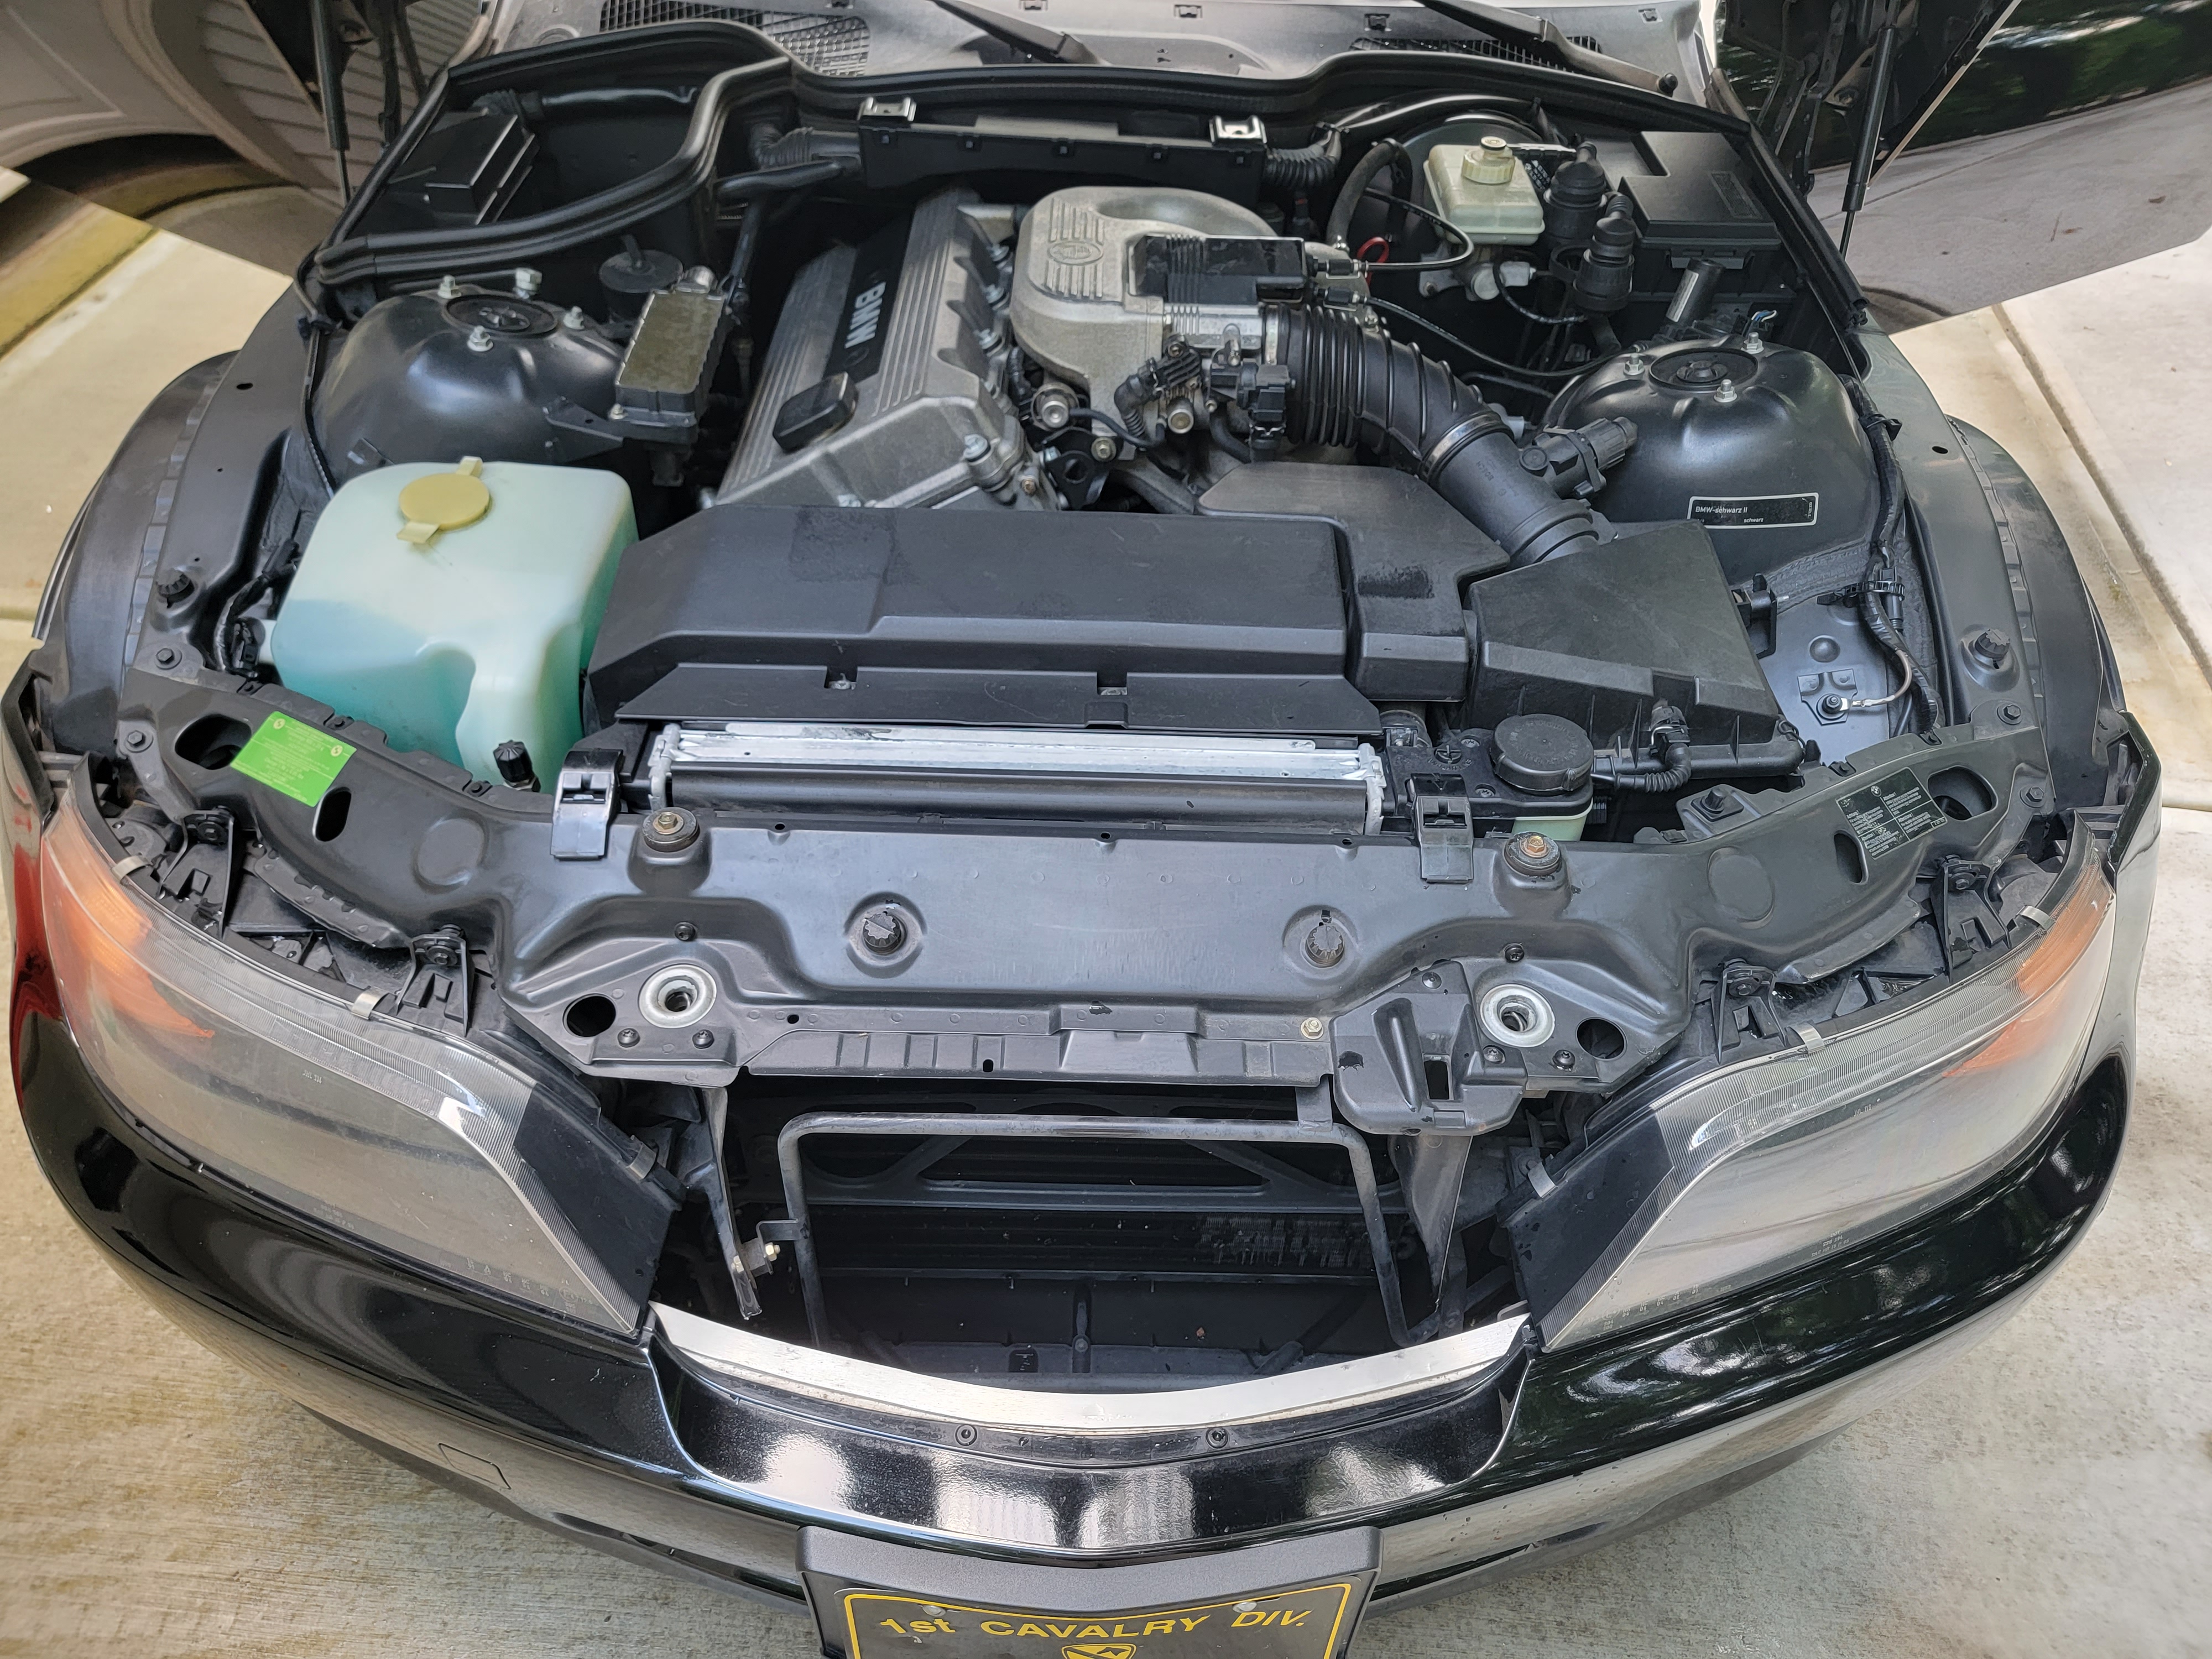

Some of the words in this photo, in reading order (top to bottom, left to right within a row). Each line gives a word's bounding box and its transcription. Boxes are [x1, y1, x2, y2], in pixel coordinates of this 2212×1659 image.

[844, 281, 886, 349] BMW
[1695, 505, 1743, 514] BMW-schwarz
[880, 1618, 955, 1634] 1st
[981, 1615, 1210, 1639] CAVALRY
[1231, 1610, 1311, 1627] DIV.
